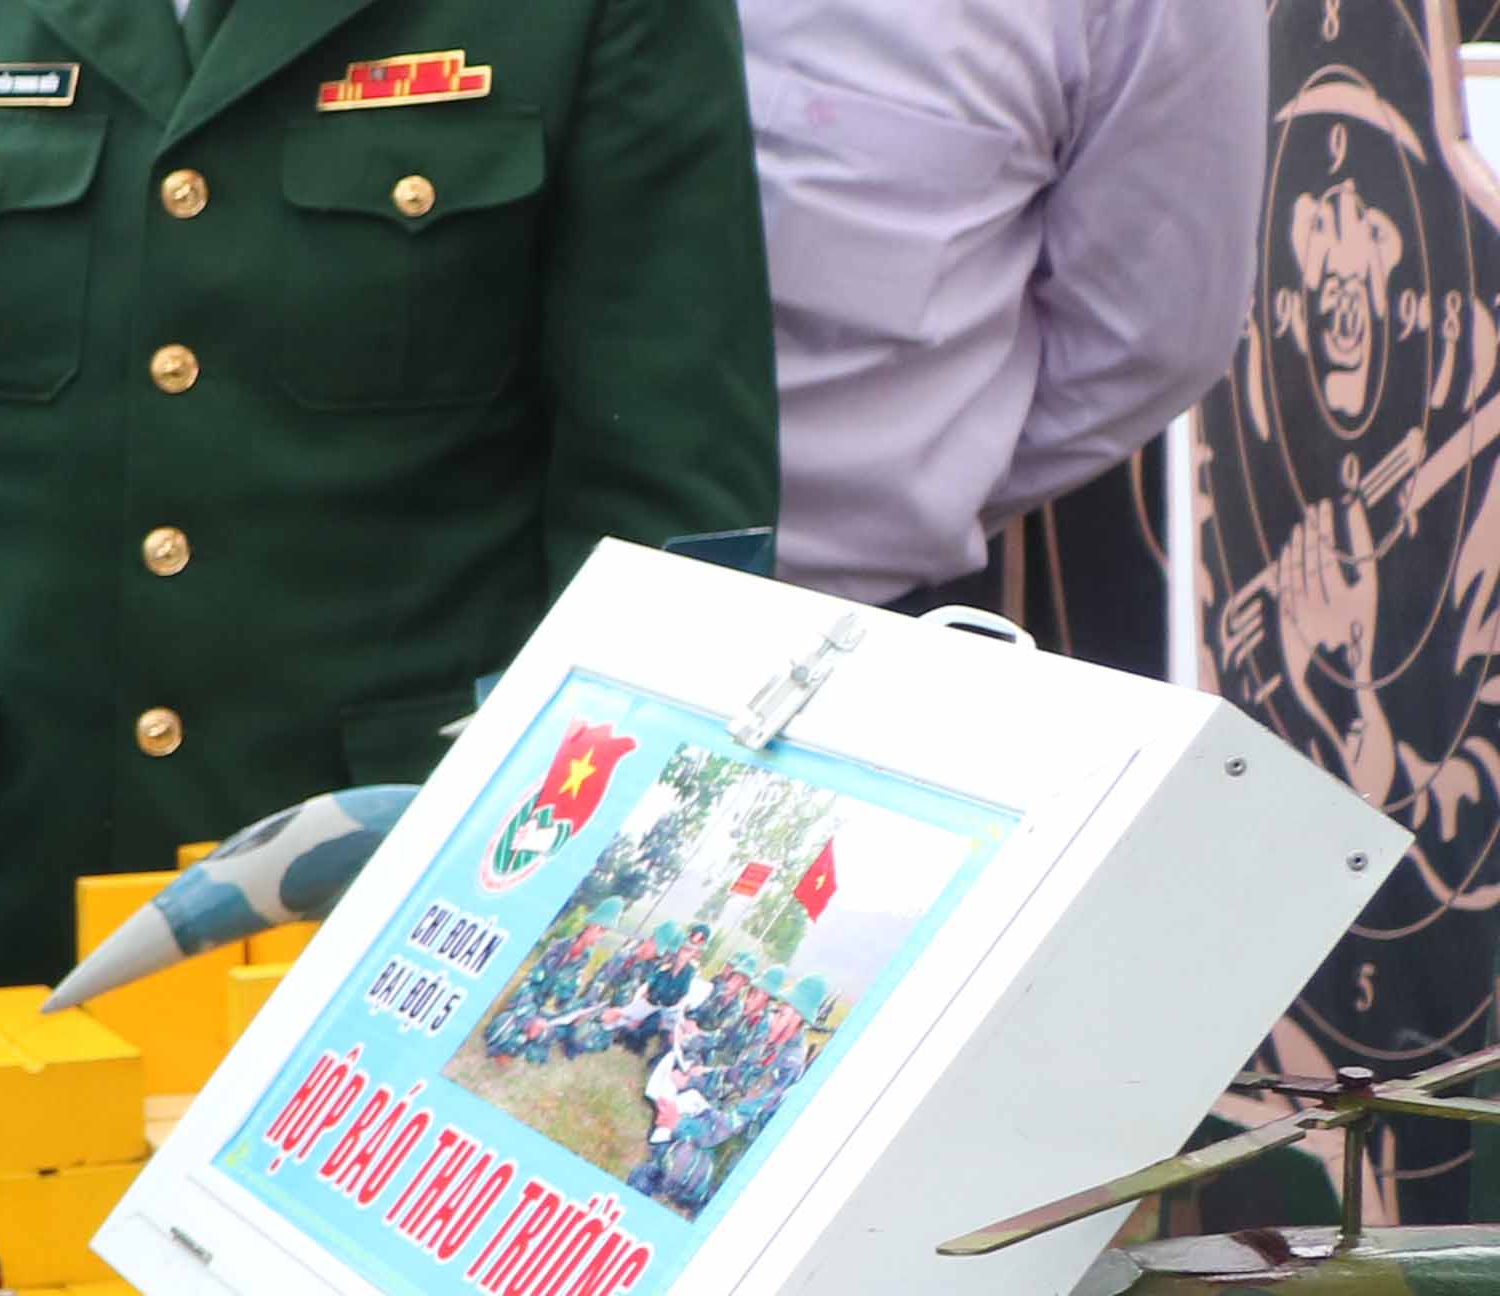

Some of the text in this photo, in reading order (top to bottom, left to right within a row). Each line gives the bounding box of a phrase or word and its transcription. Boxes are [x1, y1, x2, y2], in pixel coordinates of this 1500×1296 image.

[1329, 122, 1348, 174] 9
[410, 904, 455, 947] CHI
[430, 993, 461, 1031] 5
[265, 1045, 366, 1173] HỘP
[319, 1081, 430, 1205] BÁO
[385, 1128, 515, 1261] THAO
